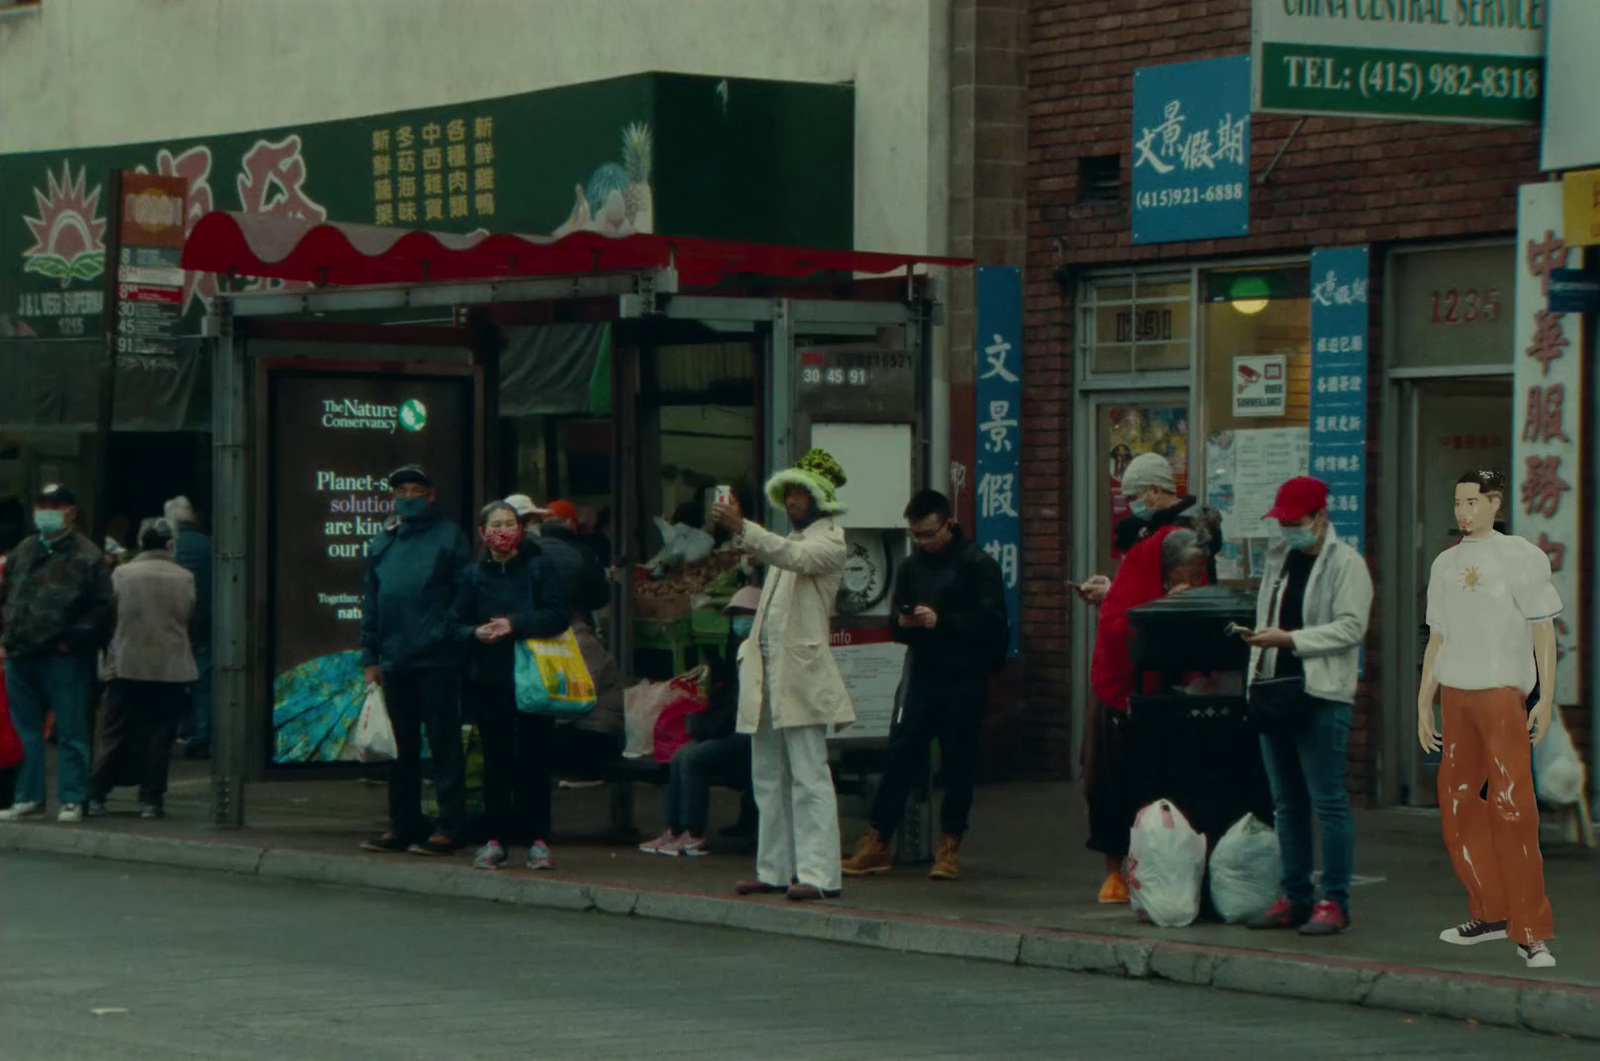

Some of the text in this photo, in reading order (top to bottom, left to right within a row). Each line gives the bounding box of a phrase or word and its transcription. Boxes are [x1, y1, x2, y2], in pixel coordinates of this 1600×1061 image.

[1283, 56, 1540, 100] TEL: (415) 982-8318
[1134, 98, 1249, 174] 文景假期
[1136, 182, 1243, 211] (415)921-6888
[118, 301, 134, 317] 30
[1430, 288, 1501, 324] 1235
[118, 319, 135, 334] 45
[118, 338, 133, 353] 91
[803, 368, 866, 384] 30 45 91
[322, 398, 398, 418] The Nature
[321, 413, 397, 434] Conservancy
[979, 333, 1020, 589] 文景假期
[324, 521, 353, 535] are
[328, 543, 360, 558] our
